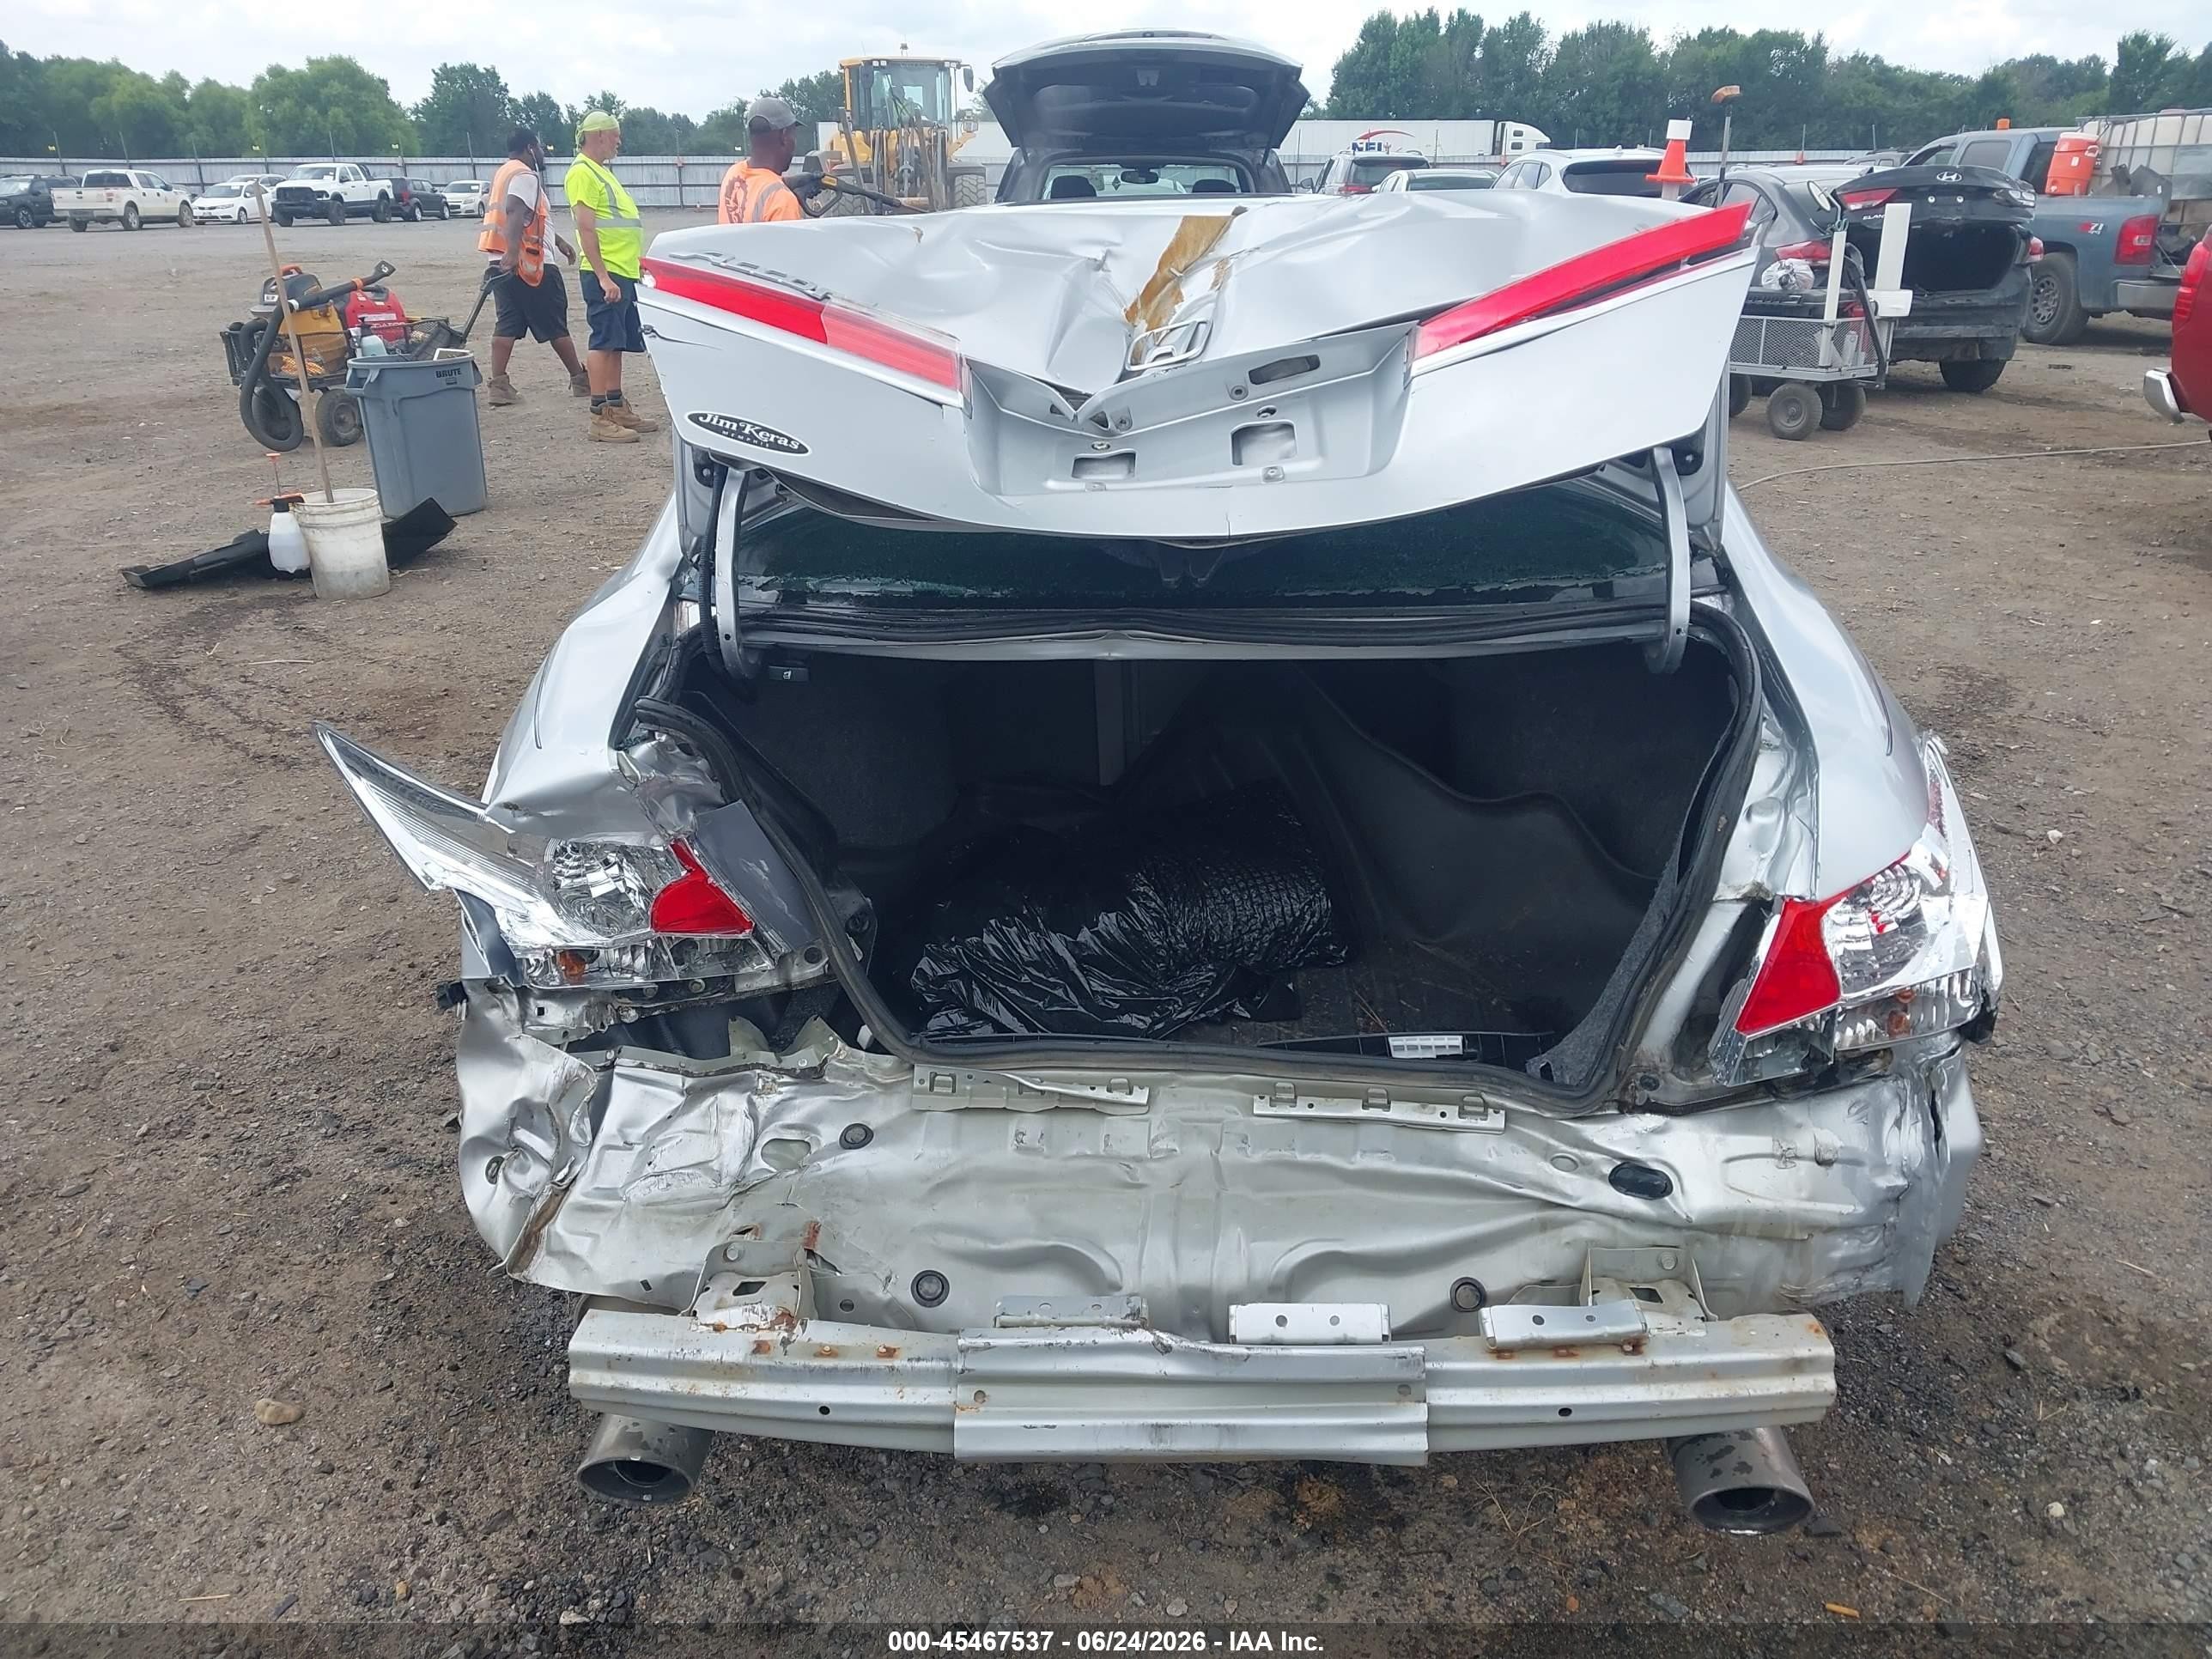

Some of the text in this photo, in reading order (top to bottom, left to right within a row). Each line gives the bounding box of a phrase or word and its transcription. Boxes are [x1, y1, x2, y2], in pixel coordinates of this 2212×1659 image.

[435, 368, 461, 378] BRUTE
[698, 413, 799, 449] Jim Keras
[721, 430, 770, 447] MEMPHIS
